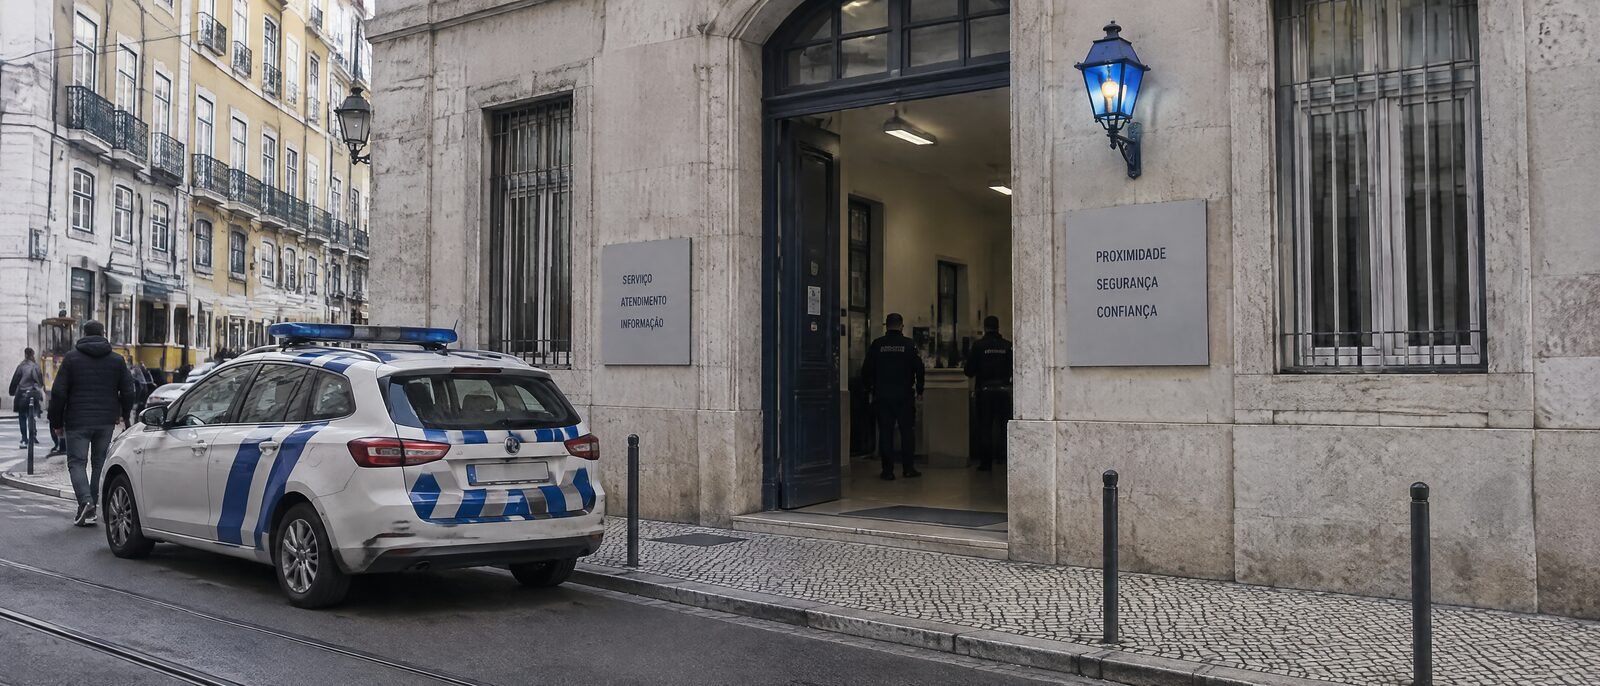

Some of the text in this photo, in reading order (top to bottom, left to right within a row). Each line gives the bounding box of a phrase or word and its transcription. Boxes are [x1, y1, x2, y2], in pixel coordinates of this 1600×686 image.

[1096, 247, 1167, 263] PROXIMIDADE
[1096, 276, 1159, 291] SEGURANÇA
[620, 295, 667, 307] ATENDIMENTO
[1096, 304, 1158, 319] CONFIANÇA
